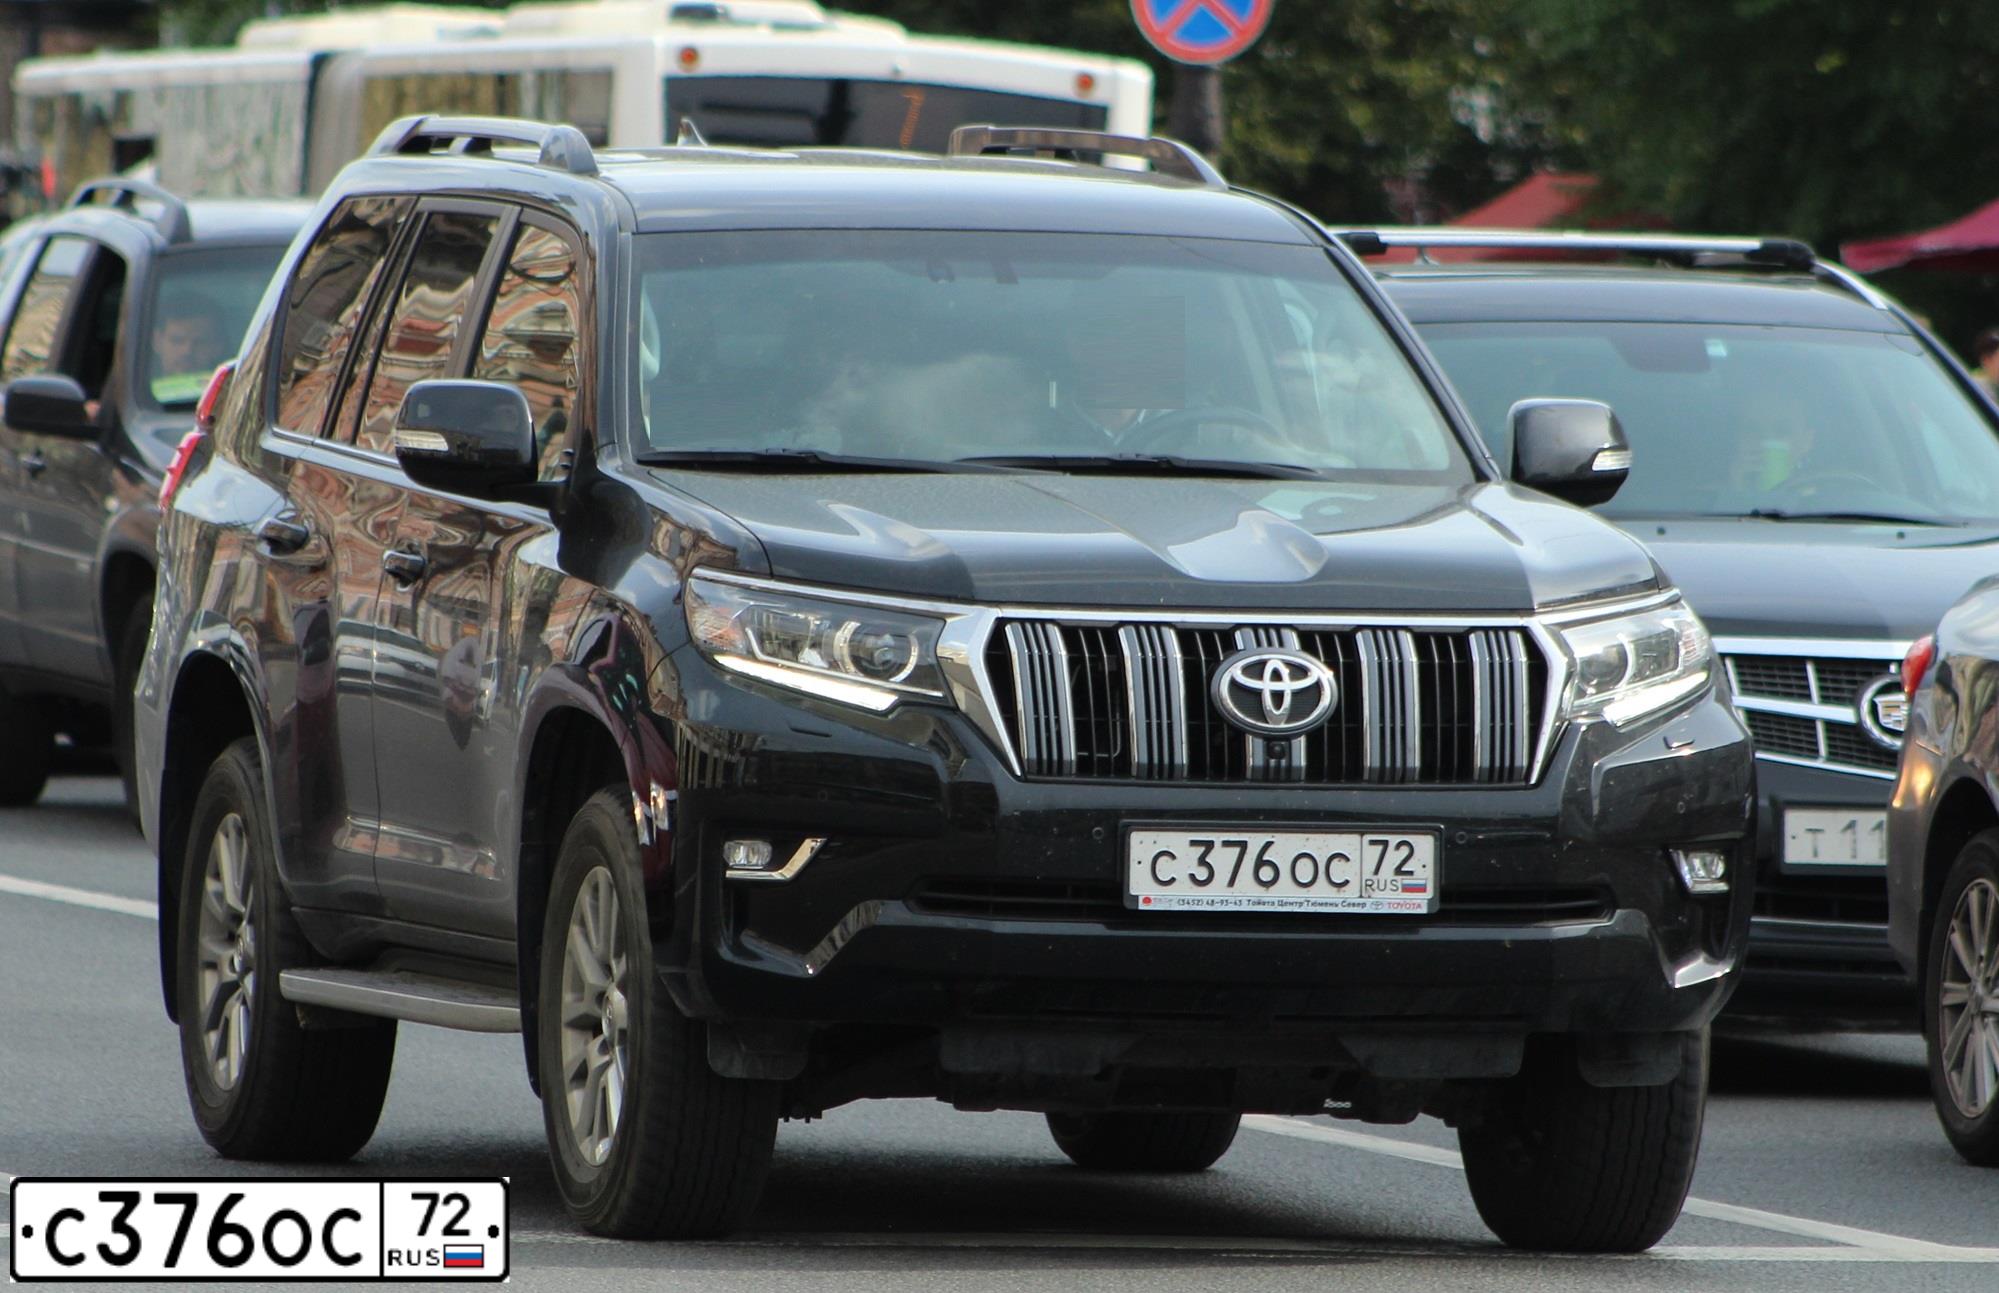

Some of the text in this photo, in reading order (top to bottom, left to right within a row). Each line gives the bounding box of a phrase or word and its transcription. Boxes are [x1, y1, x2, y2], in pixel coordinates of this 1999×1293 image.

[1368, 839, 1414, 876] 72
[1365, 879, 1399, 892] RUS
[1387, 902, 1422, 910] TOYOTA
